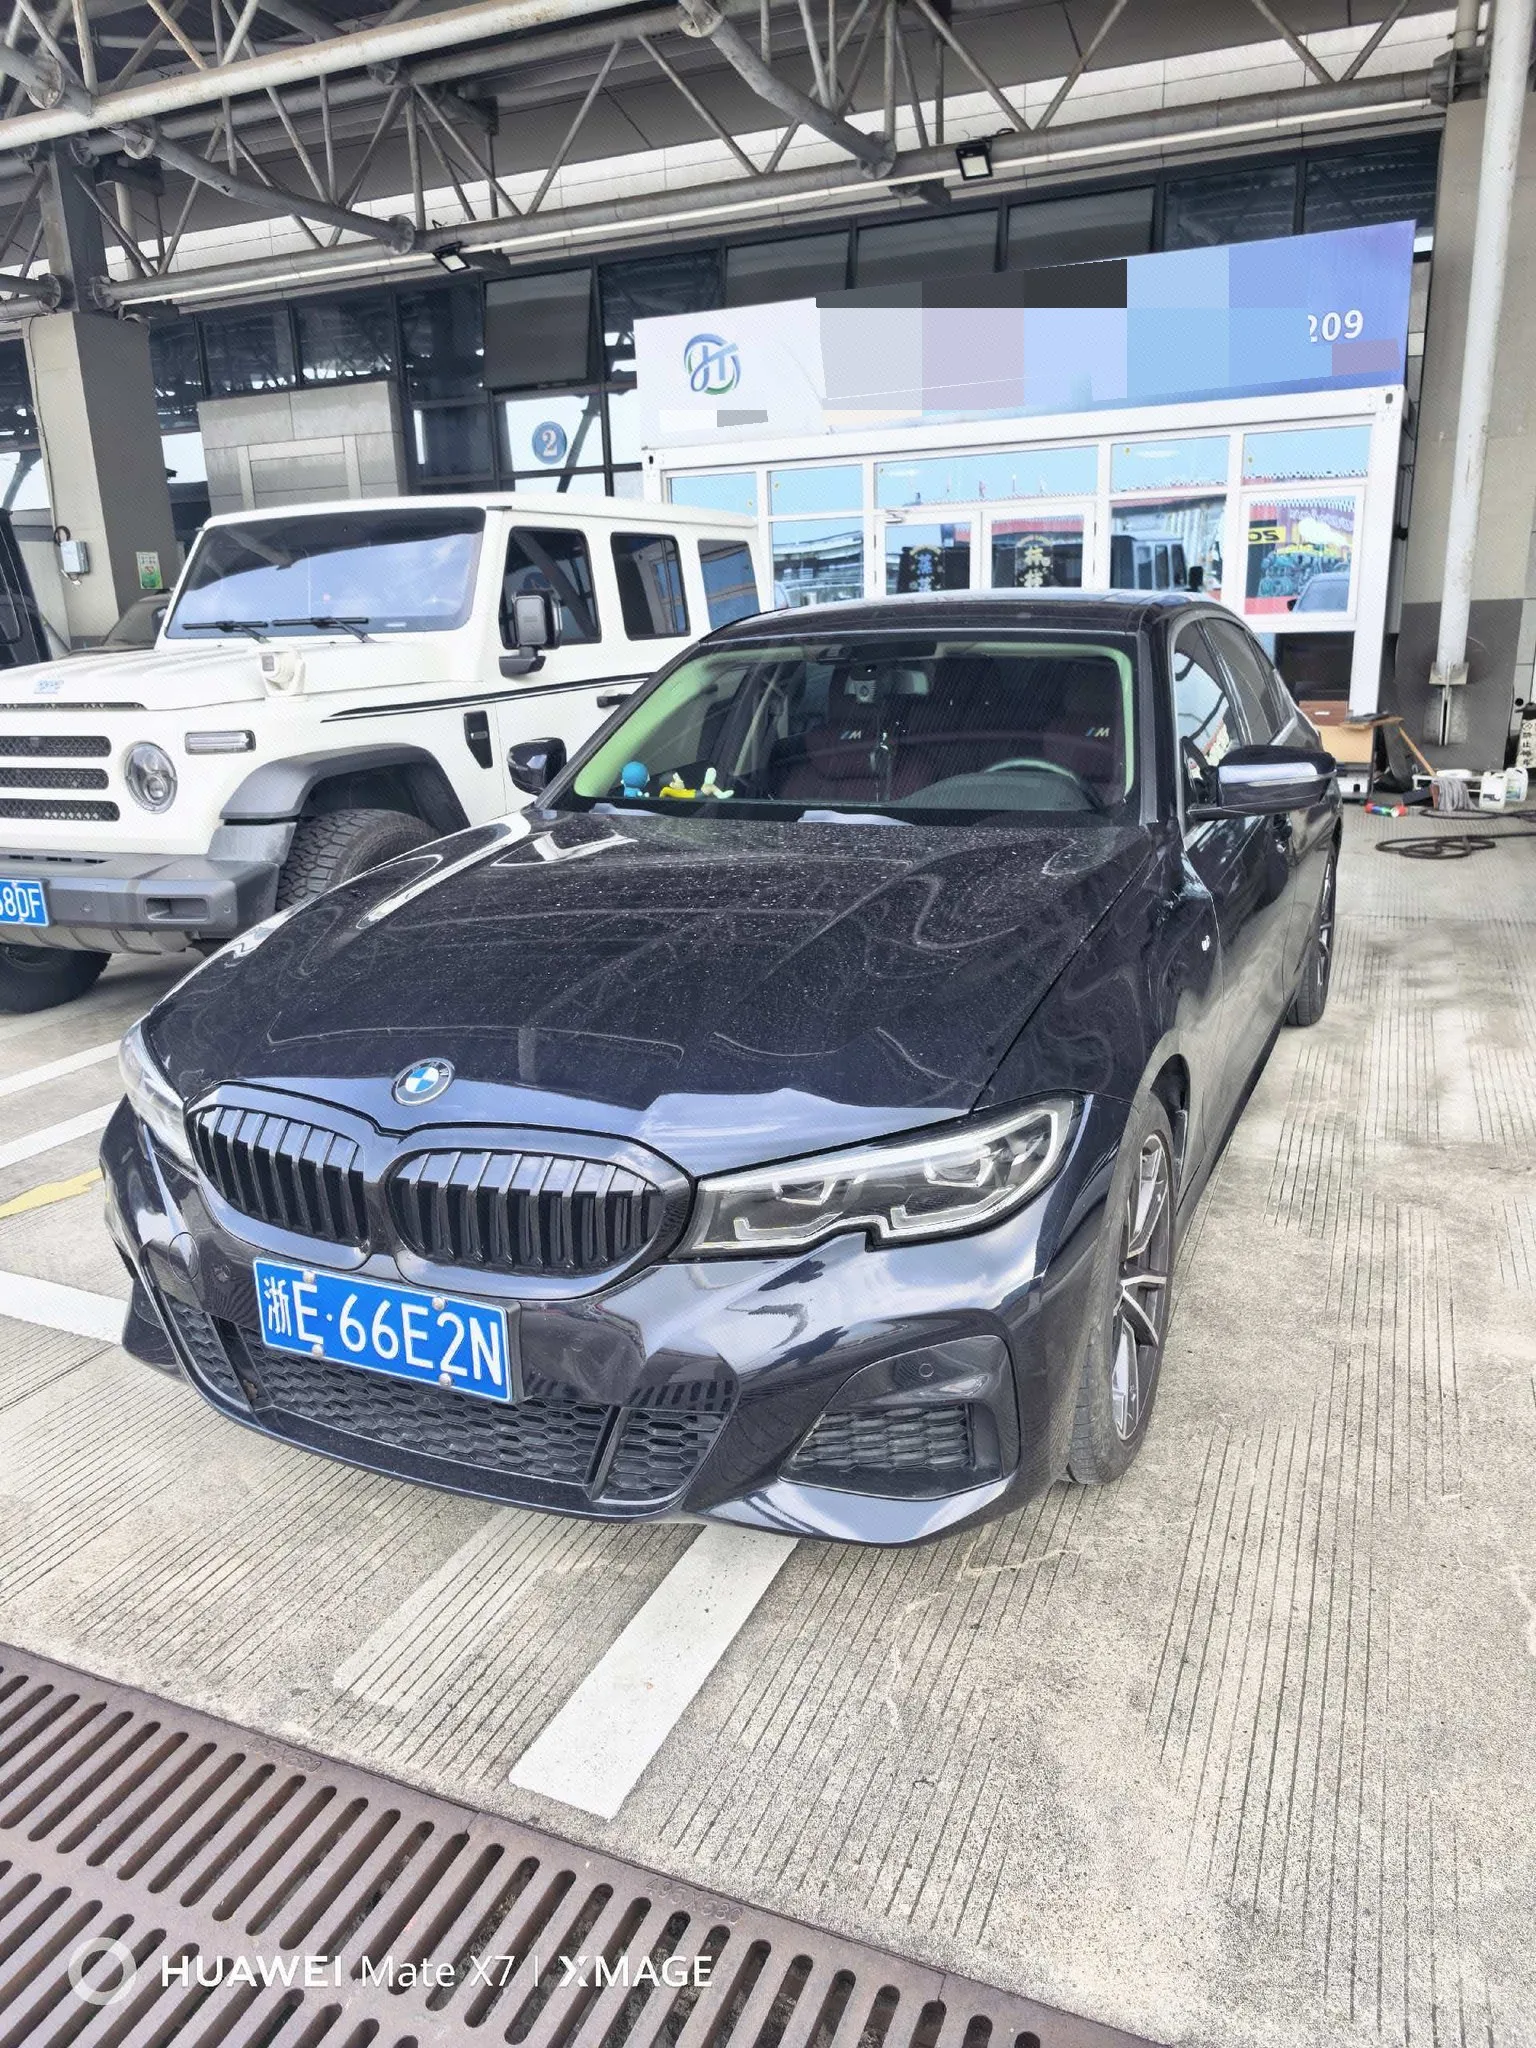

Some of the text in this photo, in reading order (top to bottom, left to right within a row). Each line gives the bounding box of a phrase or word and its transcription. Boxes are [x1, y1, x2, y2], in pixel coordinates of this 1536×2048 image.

[1307, 309, 1364, 343] 209
[542, 430, 558, 457] 2
[0, 886, 40, 919] 8DF
[264, 1276, 503, 1386] 浙E·66E2N
